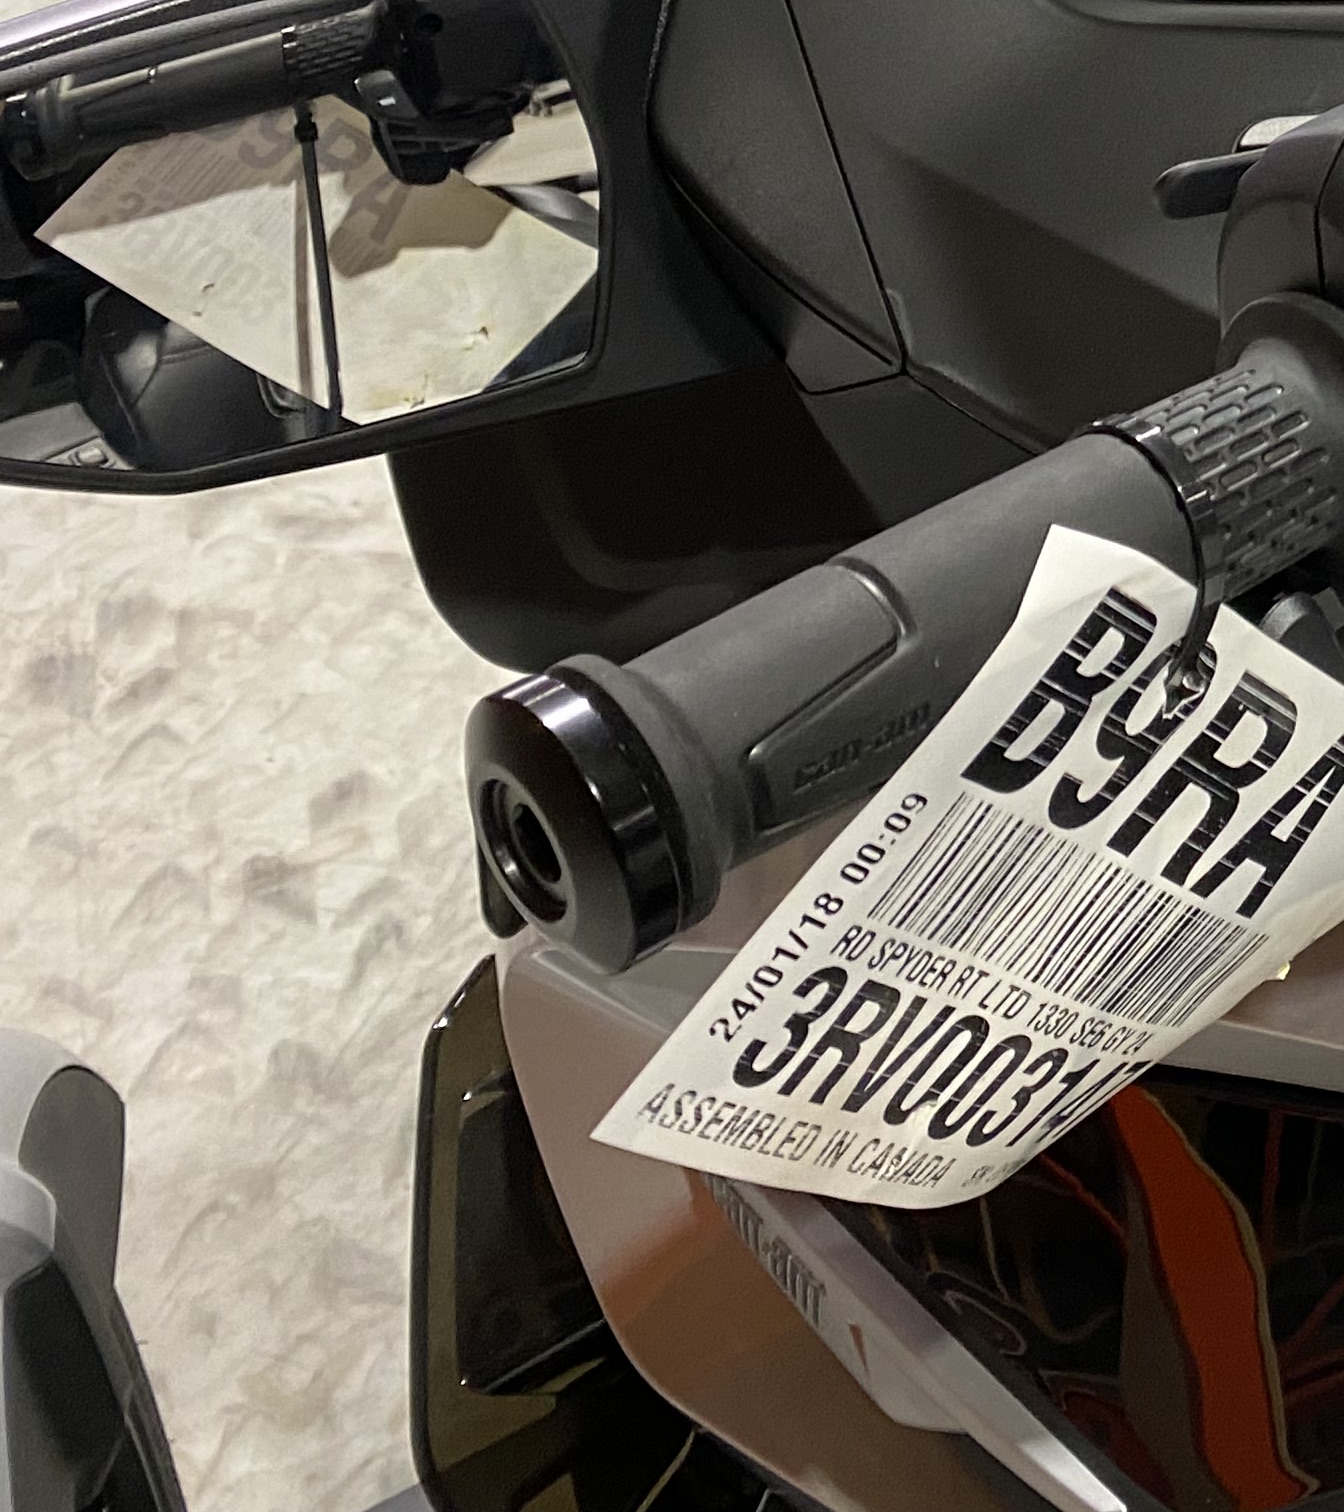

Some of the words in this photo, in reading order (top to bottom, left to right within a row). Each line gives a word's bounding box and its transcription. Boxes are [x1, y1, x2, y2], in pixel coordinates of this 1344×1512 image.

[709, 892, 844, 1043] 24/01/18
[840, 793, 928, 884] 00:09
[830, 925, 876, 962] RD
[868, 938, 958, 993] SPYDER
[946, 966, 990, 1000] RT
[978, 979, 1033, 1020] LTD
[1026, 1001, 1080, 1039] 1330
[1069, 1016, 1106, 1048] SE6
[1101, 1026, 1130, 1052] GY
[1125, 1032, 1152, 1056] 24
[637, 1083, 822, 1162] ASSEMBLED
[814, 1128, 858, 1169] IN
[847, 1137, 958, 1189] CANADA
